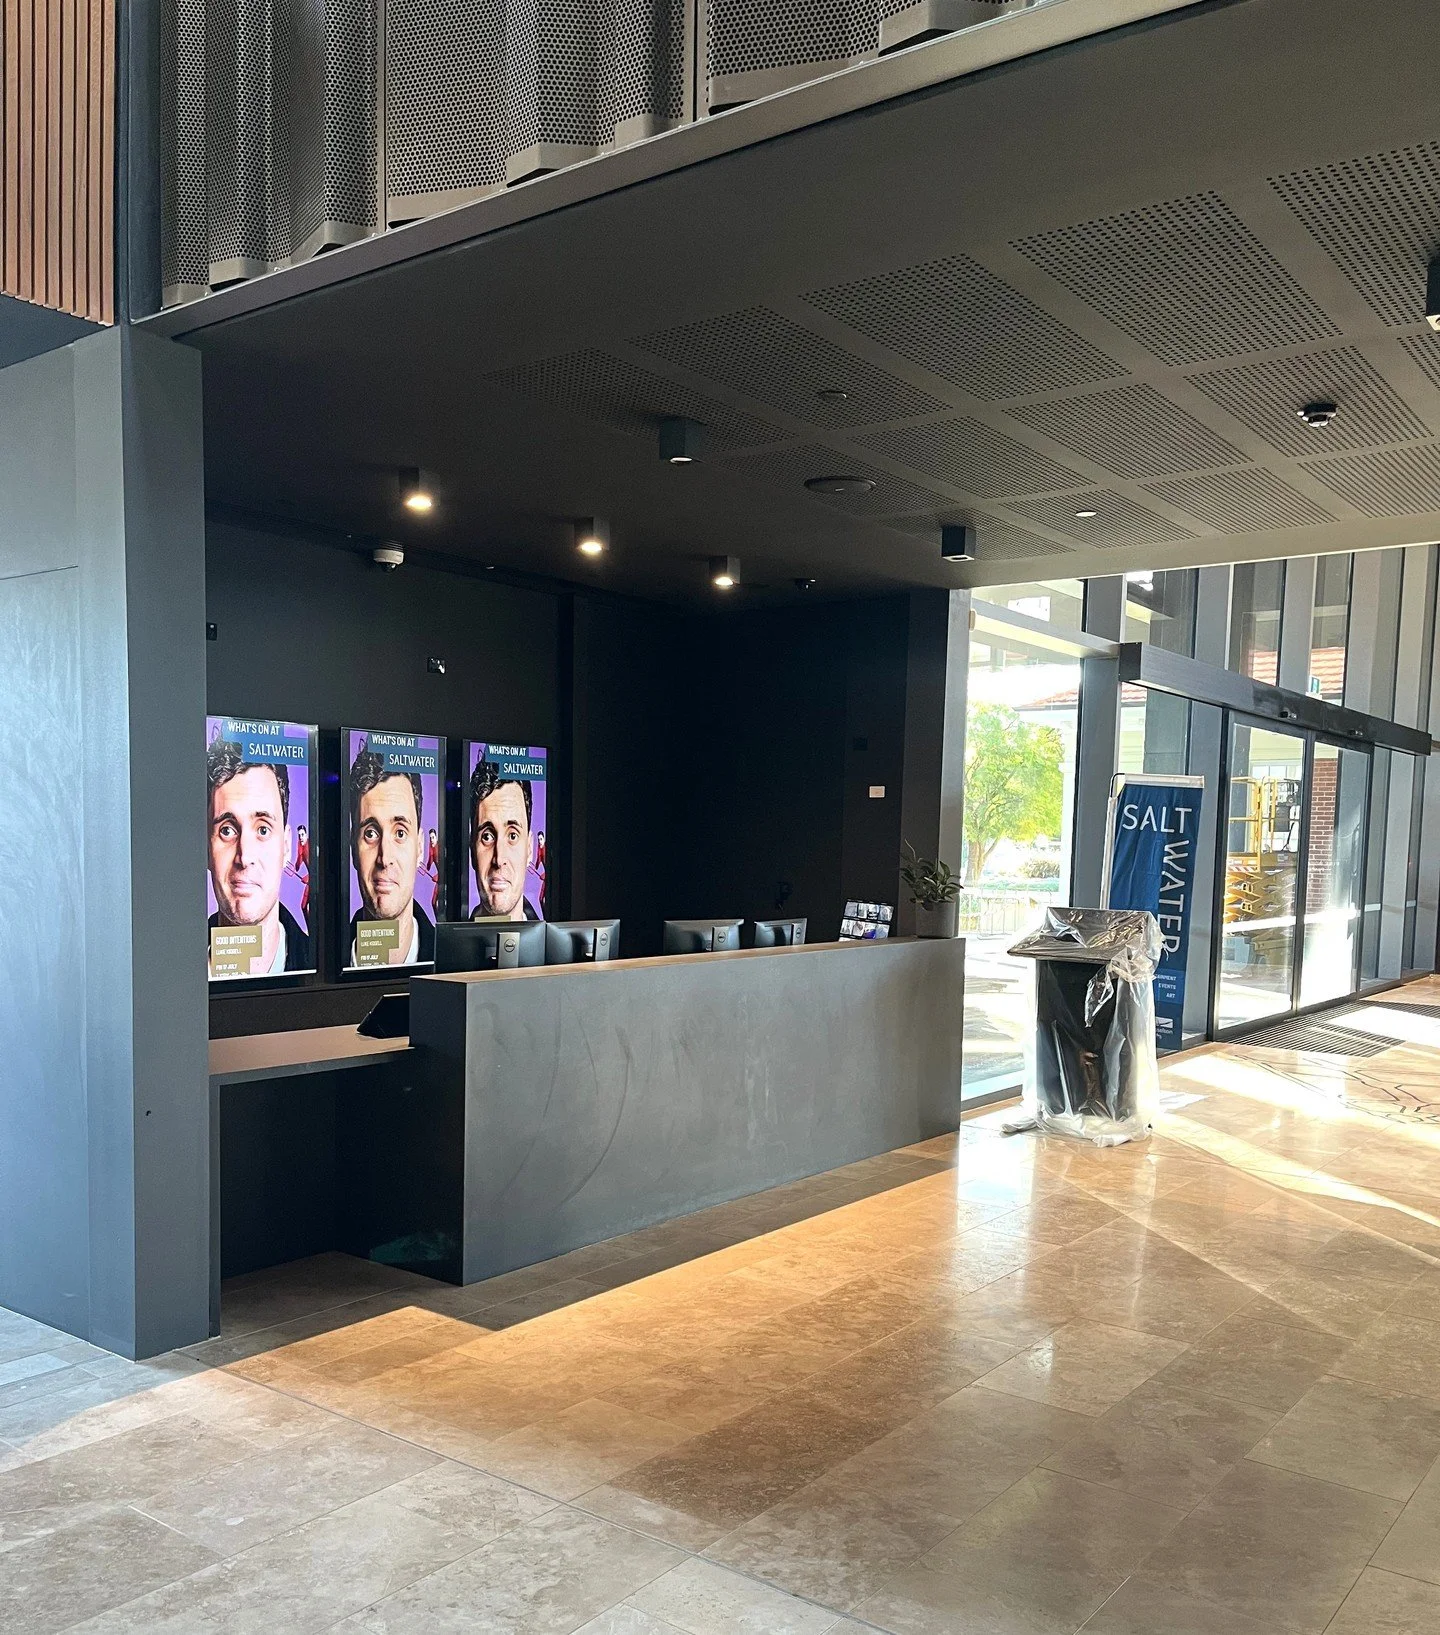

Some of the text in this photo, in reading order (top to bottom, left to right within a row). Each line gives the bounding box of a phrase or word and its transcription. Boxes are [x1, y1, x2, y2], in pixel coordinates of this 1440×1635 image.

[228, 721, 280, 736] WHAT'S ON AT
[372, 734, 415, 747] WHAT'S ON AT
[249, 742, 304, 758] SALTWATER
[488, 745, 527, 756] WHAT'S ON AT
[389, 753, 435, 768] SALTWATER
[503, 762, 543, 775] SALTWATER
[1122, 804, 1192, 834] SALT
[1157, 839, 1190, 954] WATER
[1158, 982, 1176, 990] EVENTS
